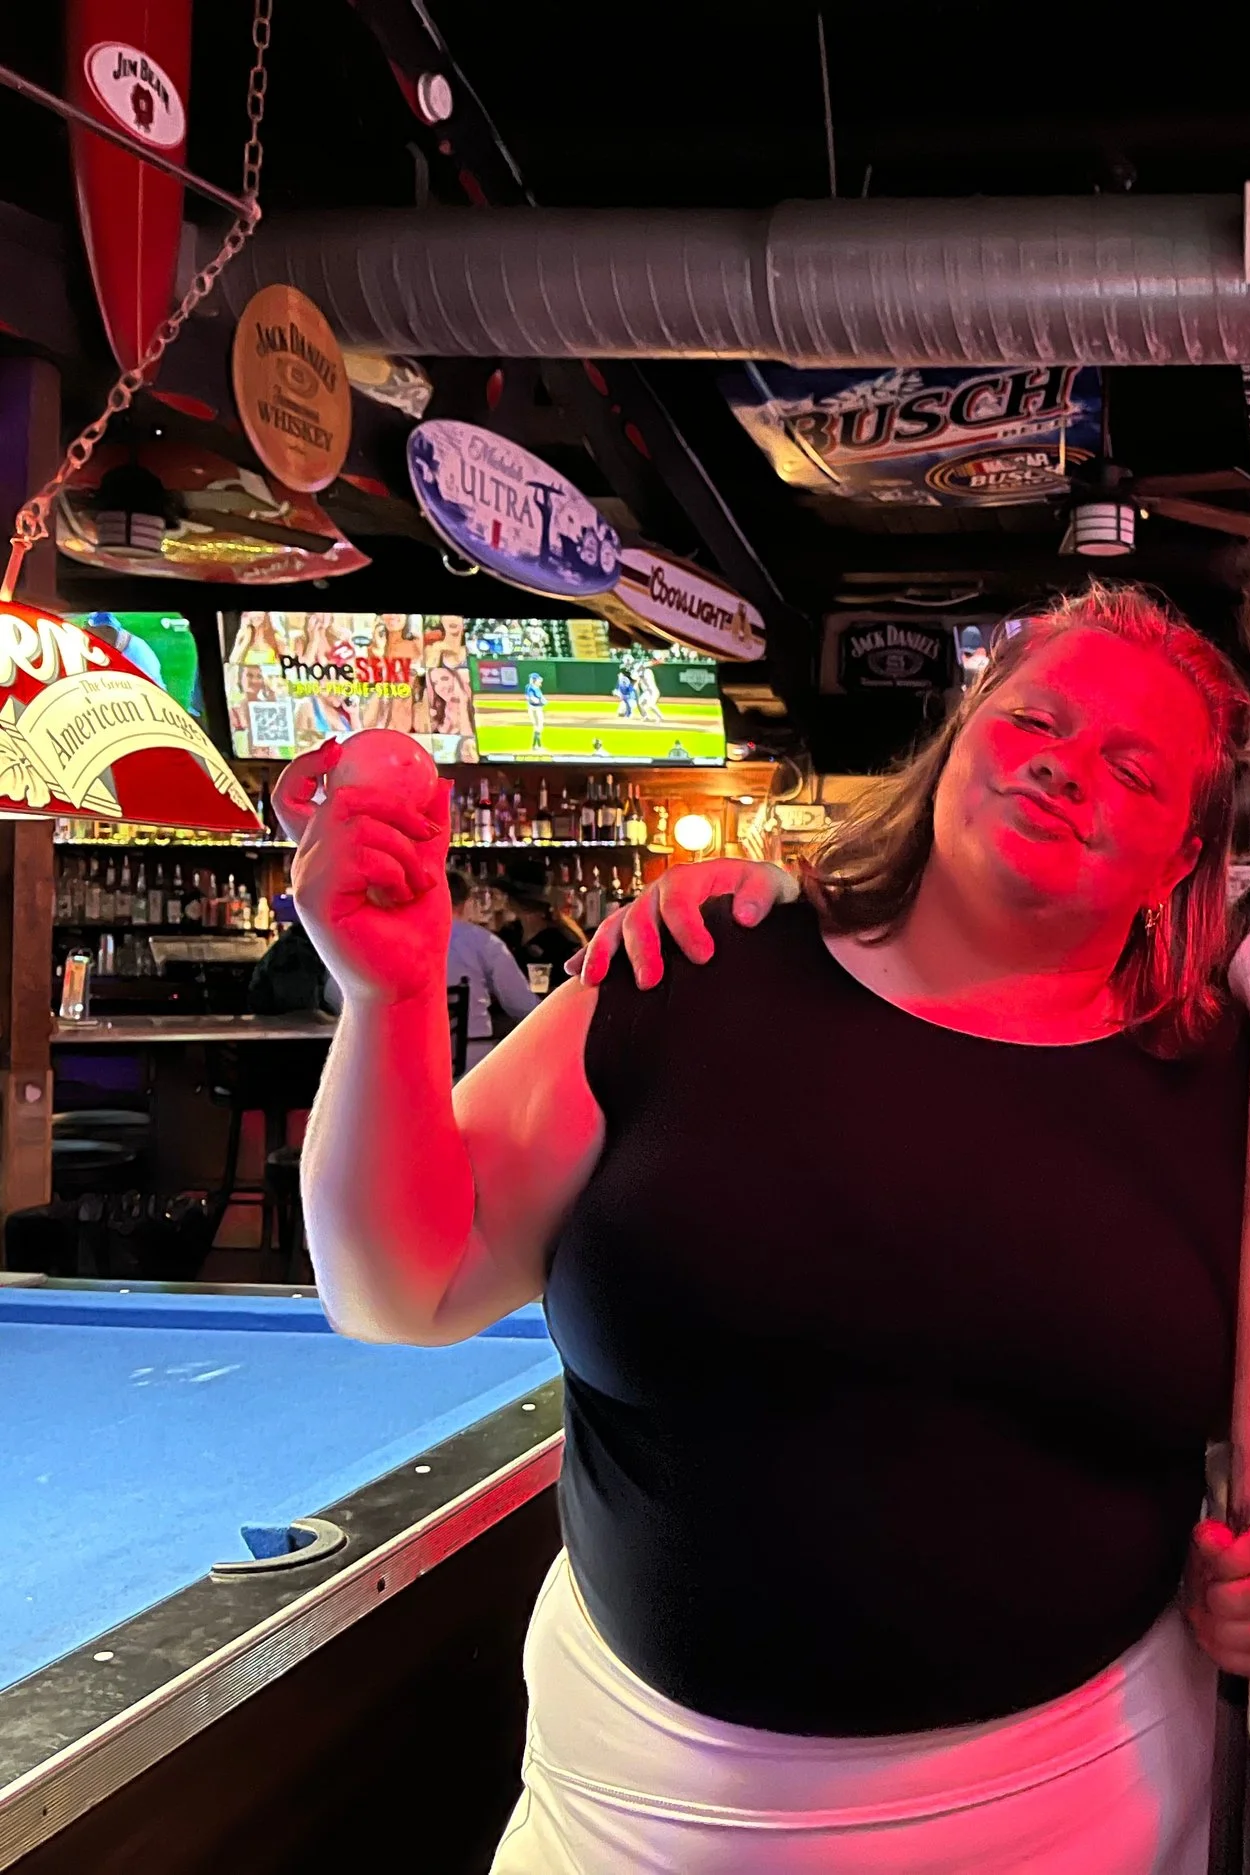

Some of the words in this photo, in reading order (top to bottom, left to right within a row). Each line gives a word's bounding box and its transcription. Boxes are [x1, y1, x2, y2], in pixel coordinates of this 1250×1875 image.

[113, 52, 138, 79] JIM
[257, 401, 334, 453] WHISKEY
[780, 366, 1078, 456] BUSCH
[460, 457, 535, 529] ULTRA
[850, 631, 886, 658] JACK
[46, 697, 145, 770] American
